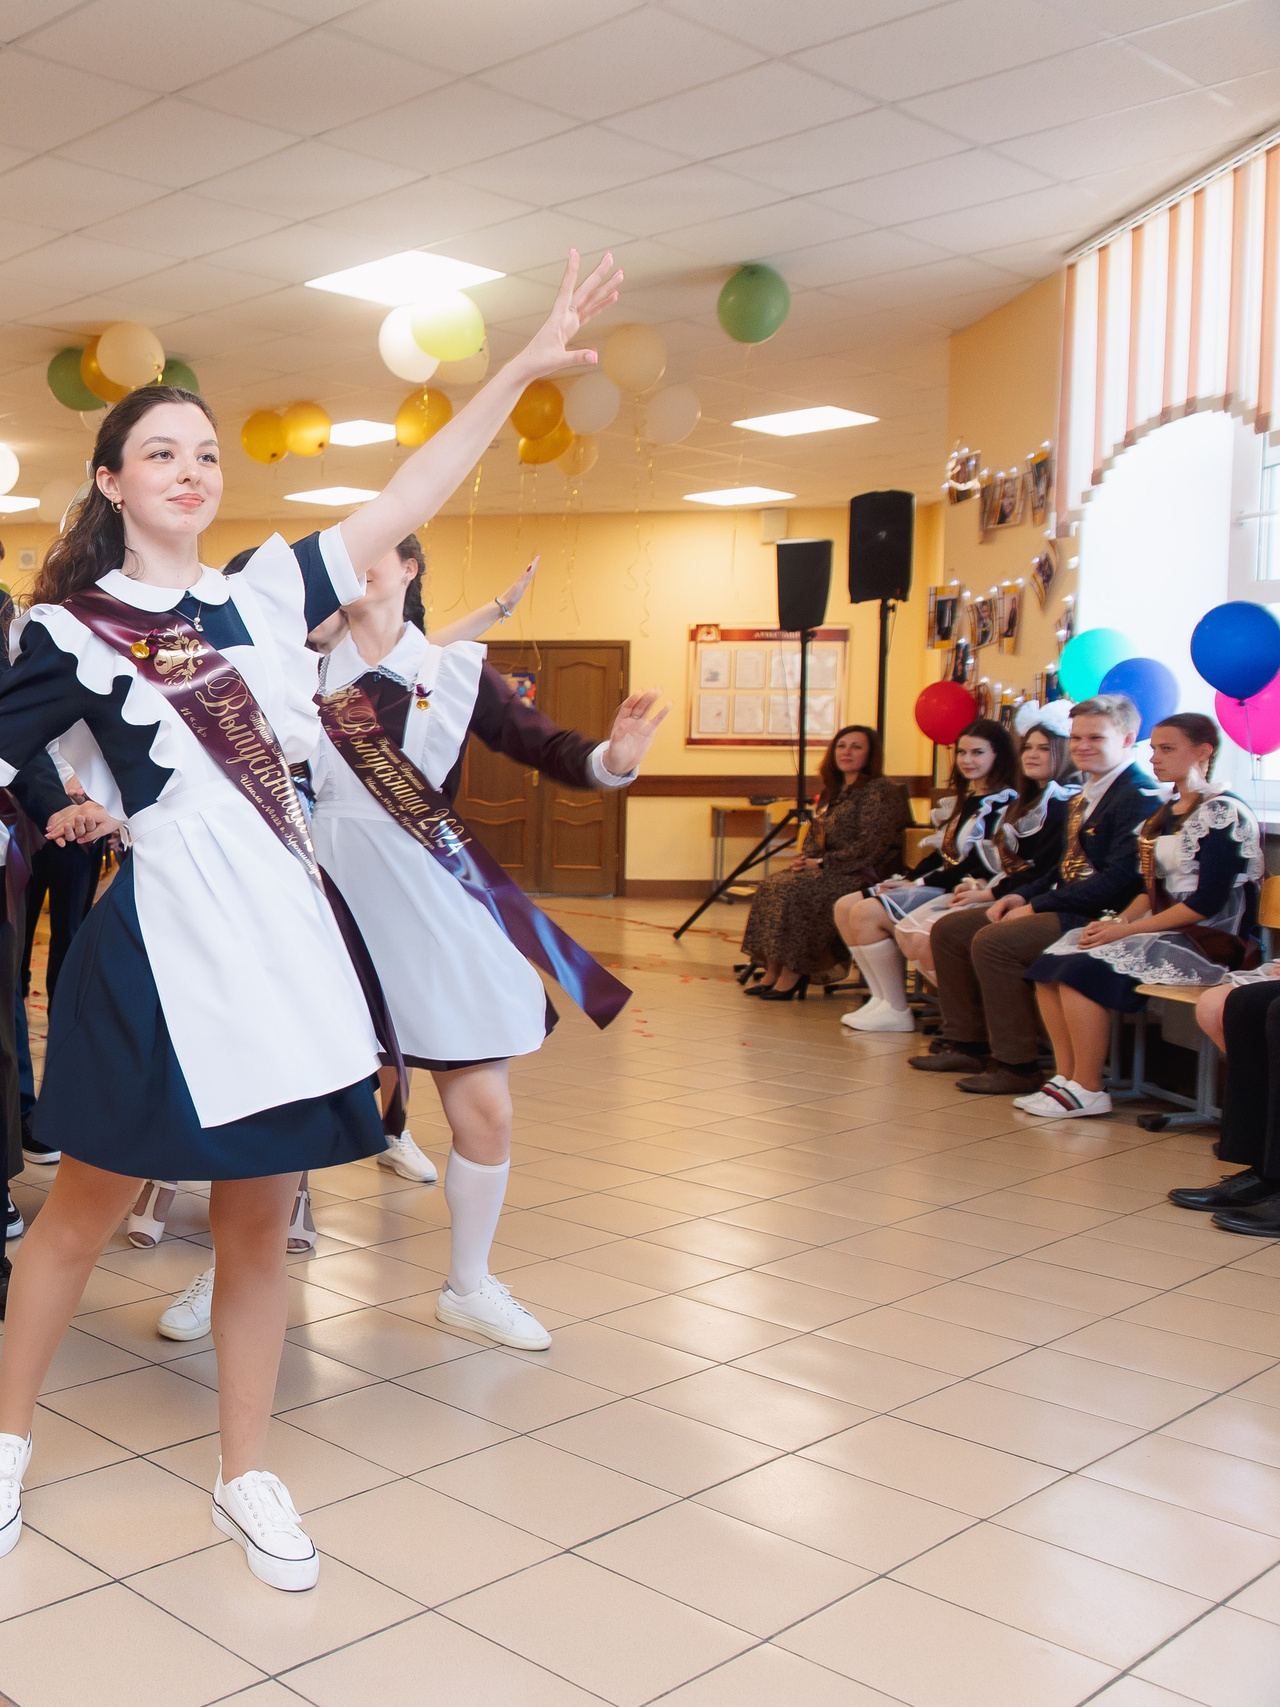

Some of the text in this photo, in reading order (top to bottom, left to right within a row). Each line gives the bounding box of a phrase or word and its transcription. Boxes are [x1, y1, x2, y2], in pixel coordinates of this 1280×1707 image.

[179, 706, 207, 738] 11 «А»
[195, 669, 307, 833] Выпускница
[239, 773, 263, 804] Школа
[262, 803, 282, 826] №422
[336, 707, 472, 857] Выпускница 2024
